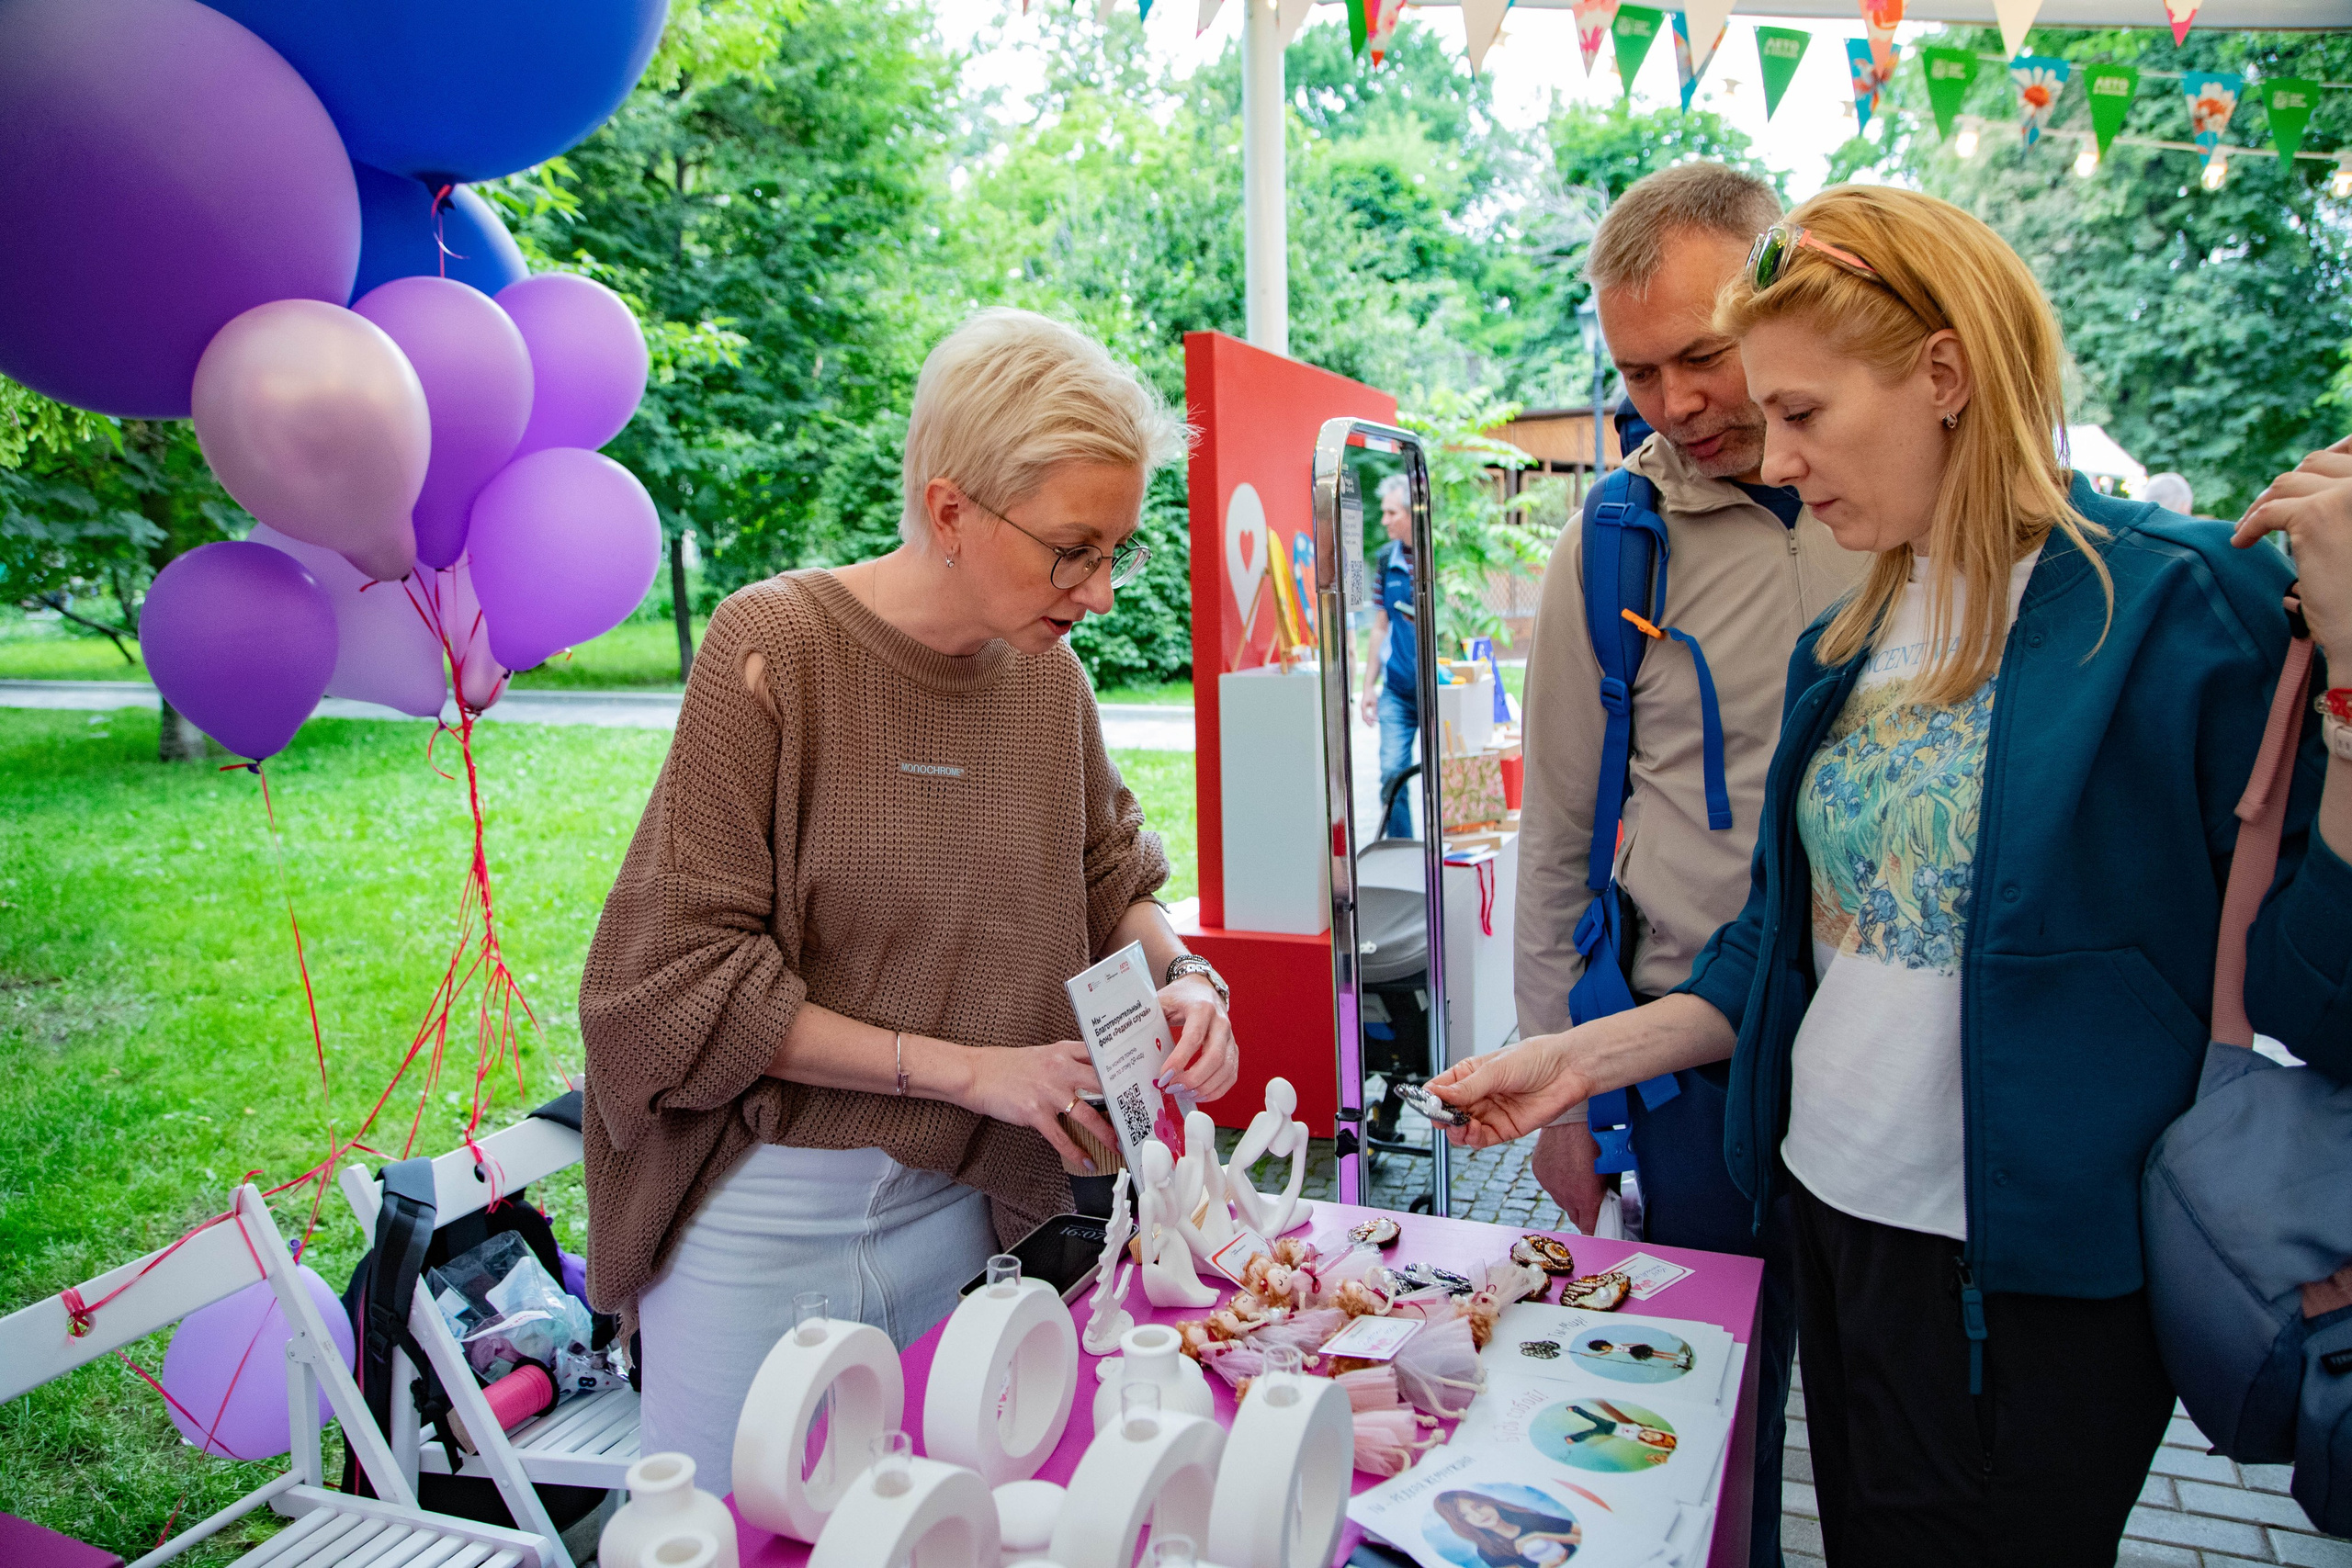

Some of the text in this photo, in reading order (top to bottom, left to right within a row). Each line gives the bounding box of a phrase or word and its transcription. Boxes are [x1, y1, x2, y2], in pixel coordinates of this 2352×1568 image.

[1091, 1016, 1102, 1027] Мы
[1094, 999, 1142, 1037] Благотворительный
[1099, 1033, 1113, 1048] фонд
[1059, 1226, 1107, 1240] 16:07
